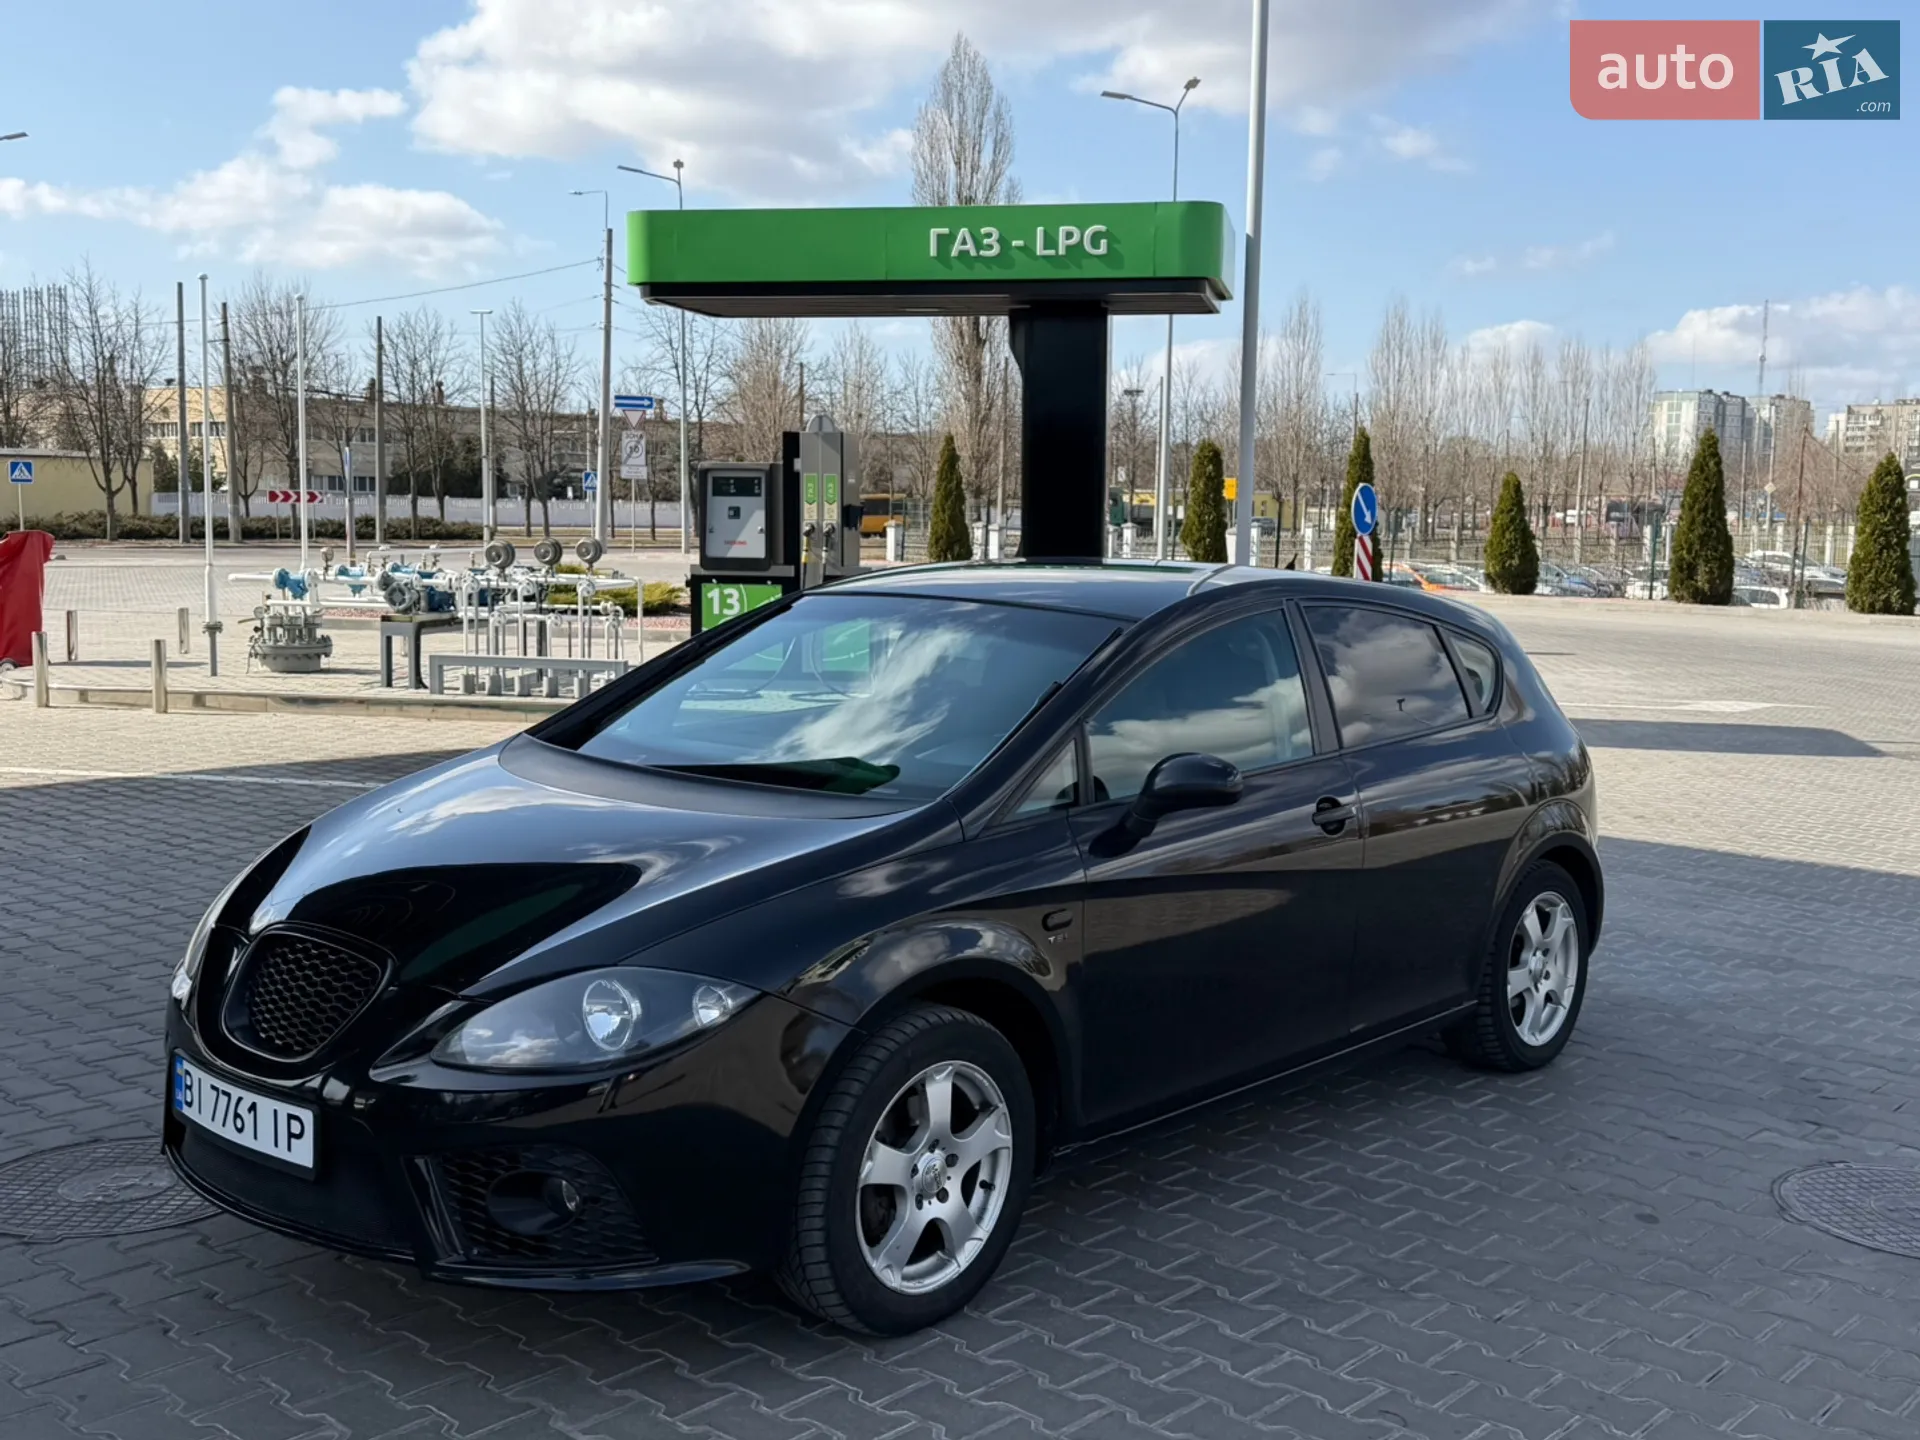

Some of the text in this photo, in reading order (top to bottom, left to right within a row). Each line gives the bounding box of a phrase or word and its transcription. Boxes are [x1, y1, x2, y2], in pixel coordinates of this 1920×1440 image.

[929, 226, 1002, 257] ГАЗ
[1036, 224, 1109, 256] LPG
[706, 587, 741, 616] 13
[183, 1068, 306, 1153] BI 7761 IP
